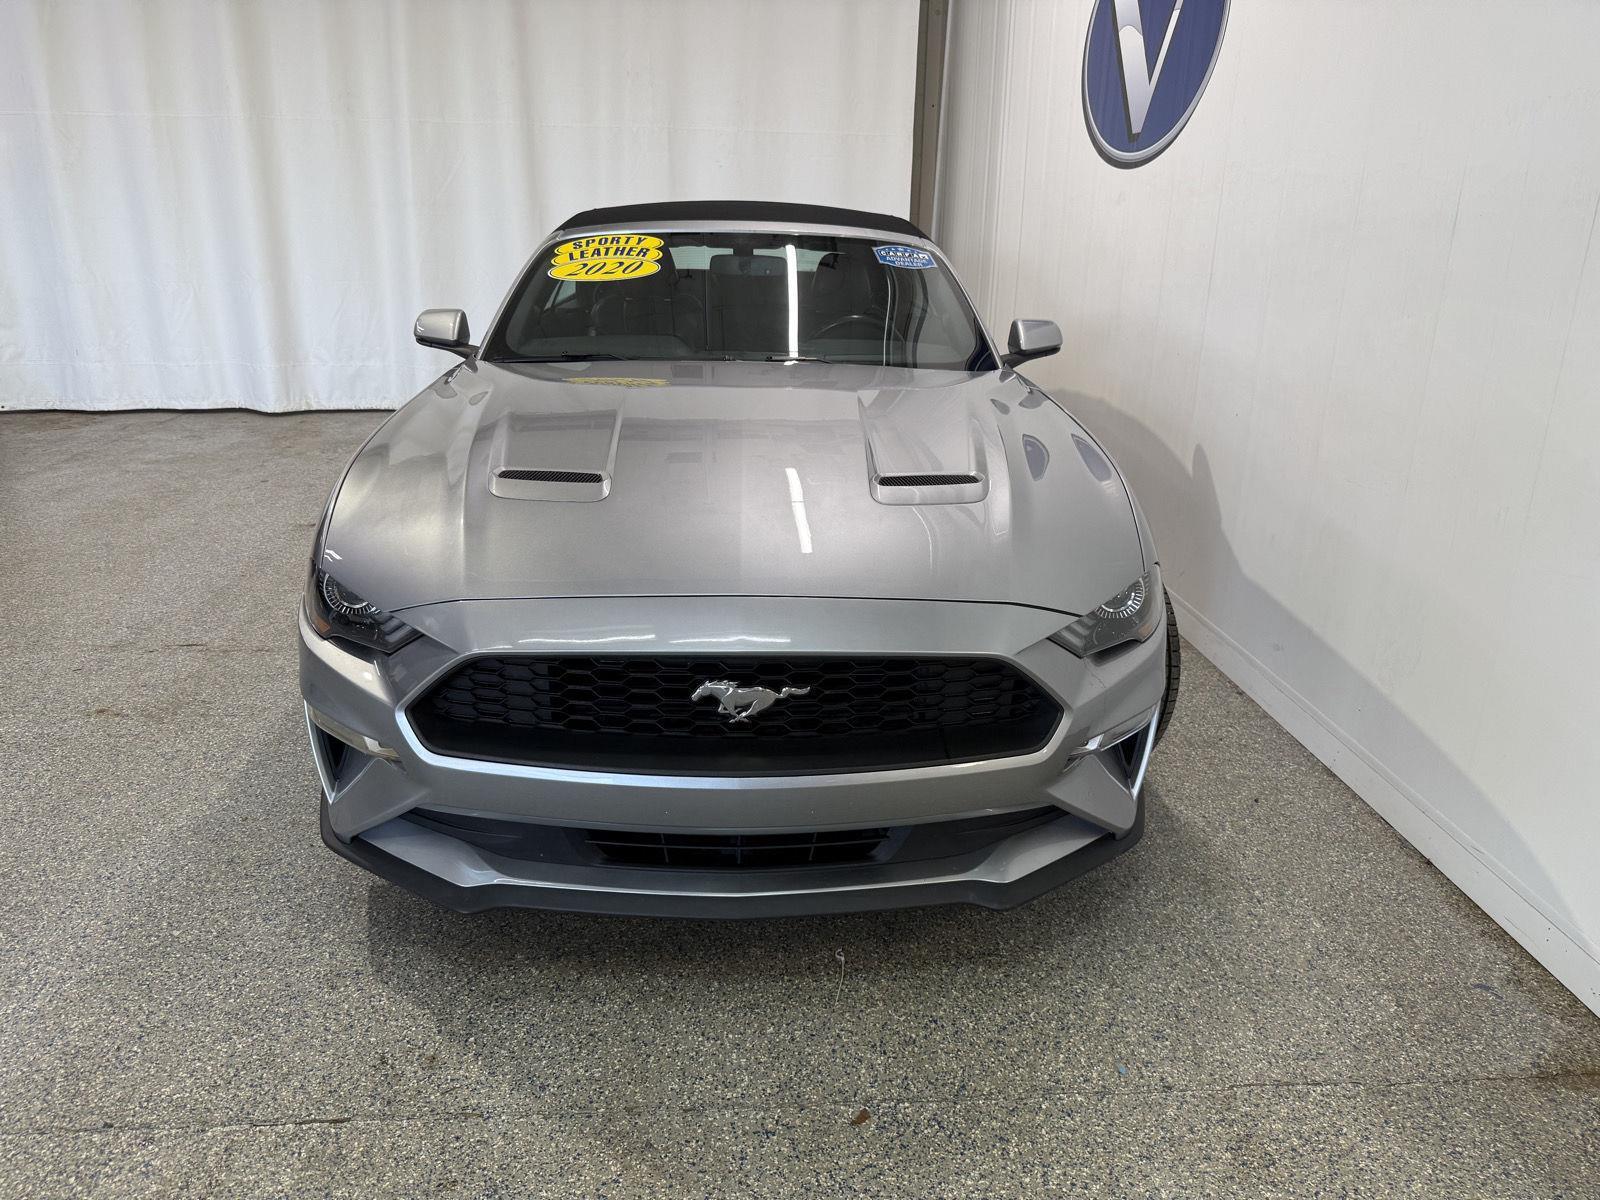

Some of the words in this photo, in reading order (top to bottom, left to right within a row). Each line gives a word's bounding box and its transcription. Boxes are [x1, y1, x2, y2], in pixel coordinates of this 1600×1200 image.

[572, 236, 648, 250] SPORTY
[568, 246, 651, 261] LEATHER
[564, 260, 645, 277] 2020
